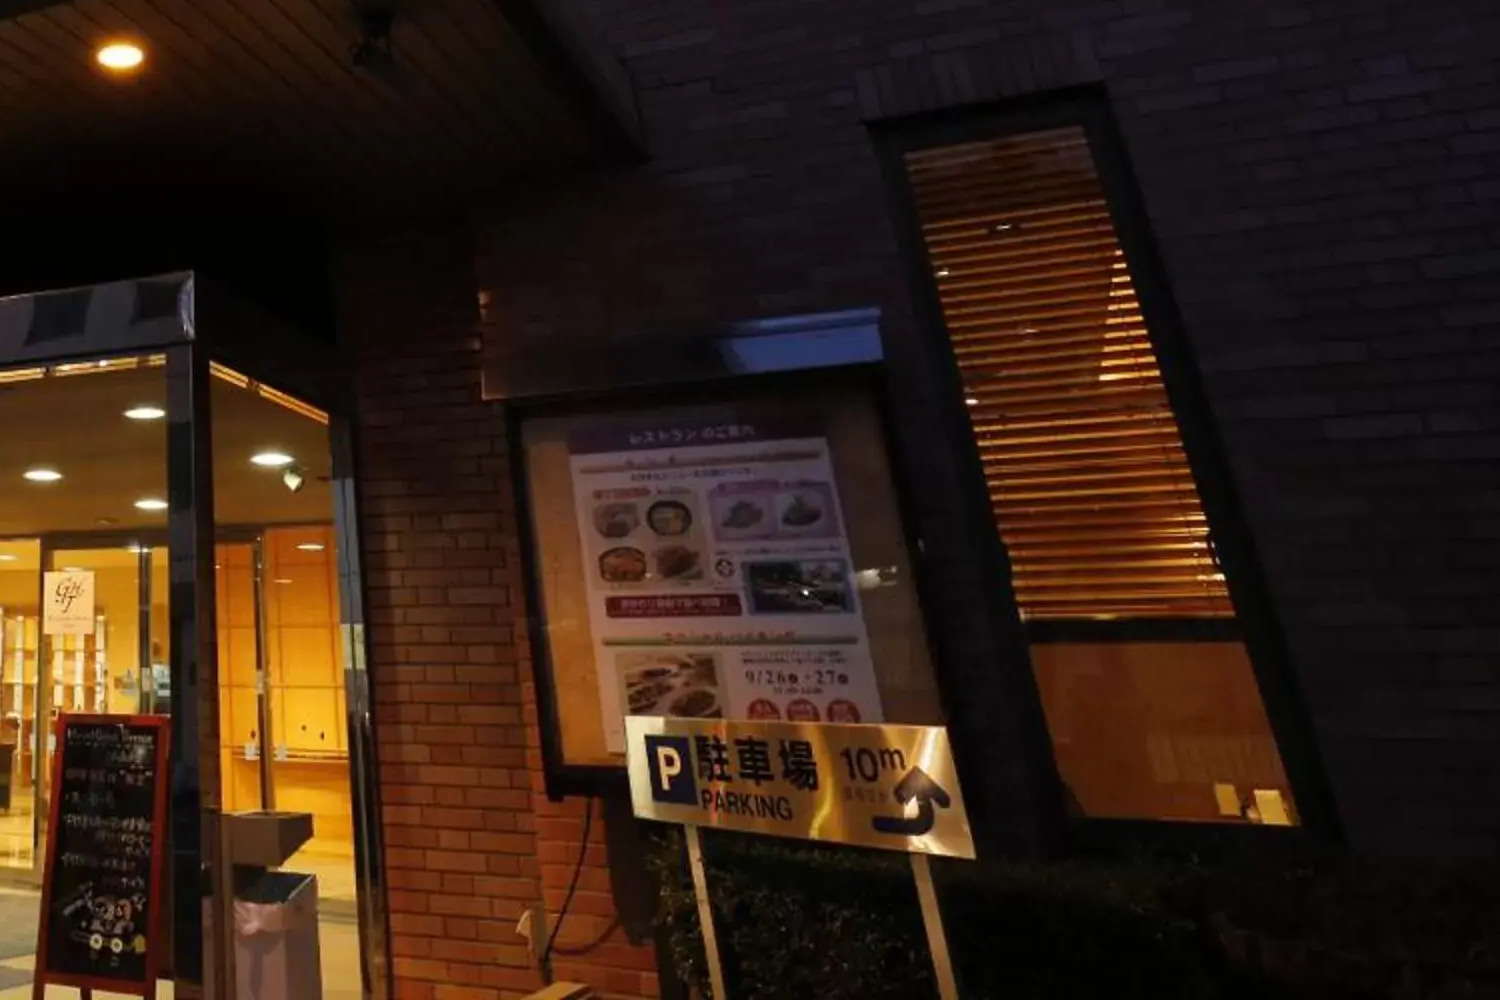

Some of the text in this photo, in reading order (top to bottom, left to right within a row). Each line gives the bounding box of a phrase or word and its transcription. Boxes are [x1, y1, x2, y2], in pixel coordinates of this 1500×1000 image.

[657, 734, 906, 792] P 駐車場 10m
[701, 789, 793, 821] PARKING
